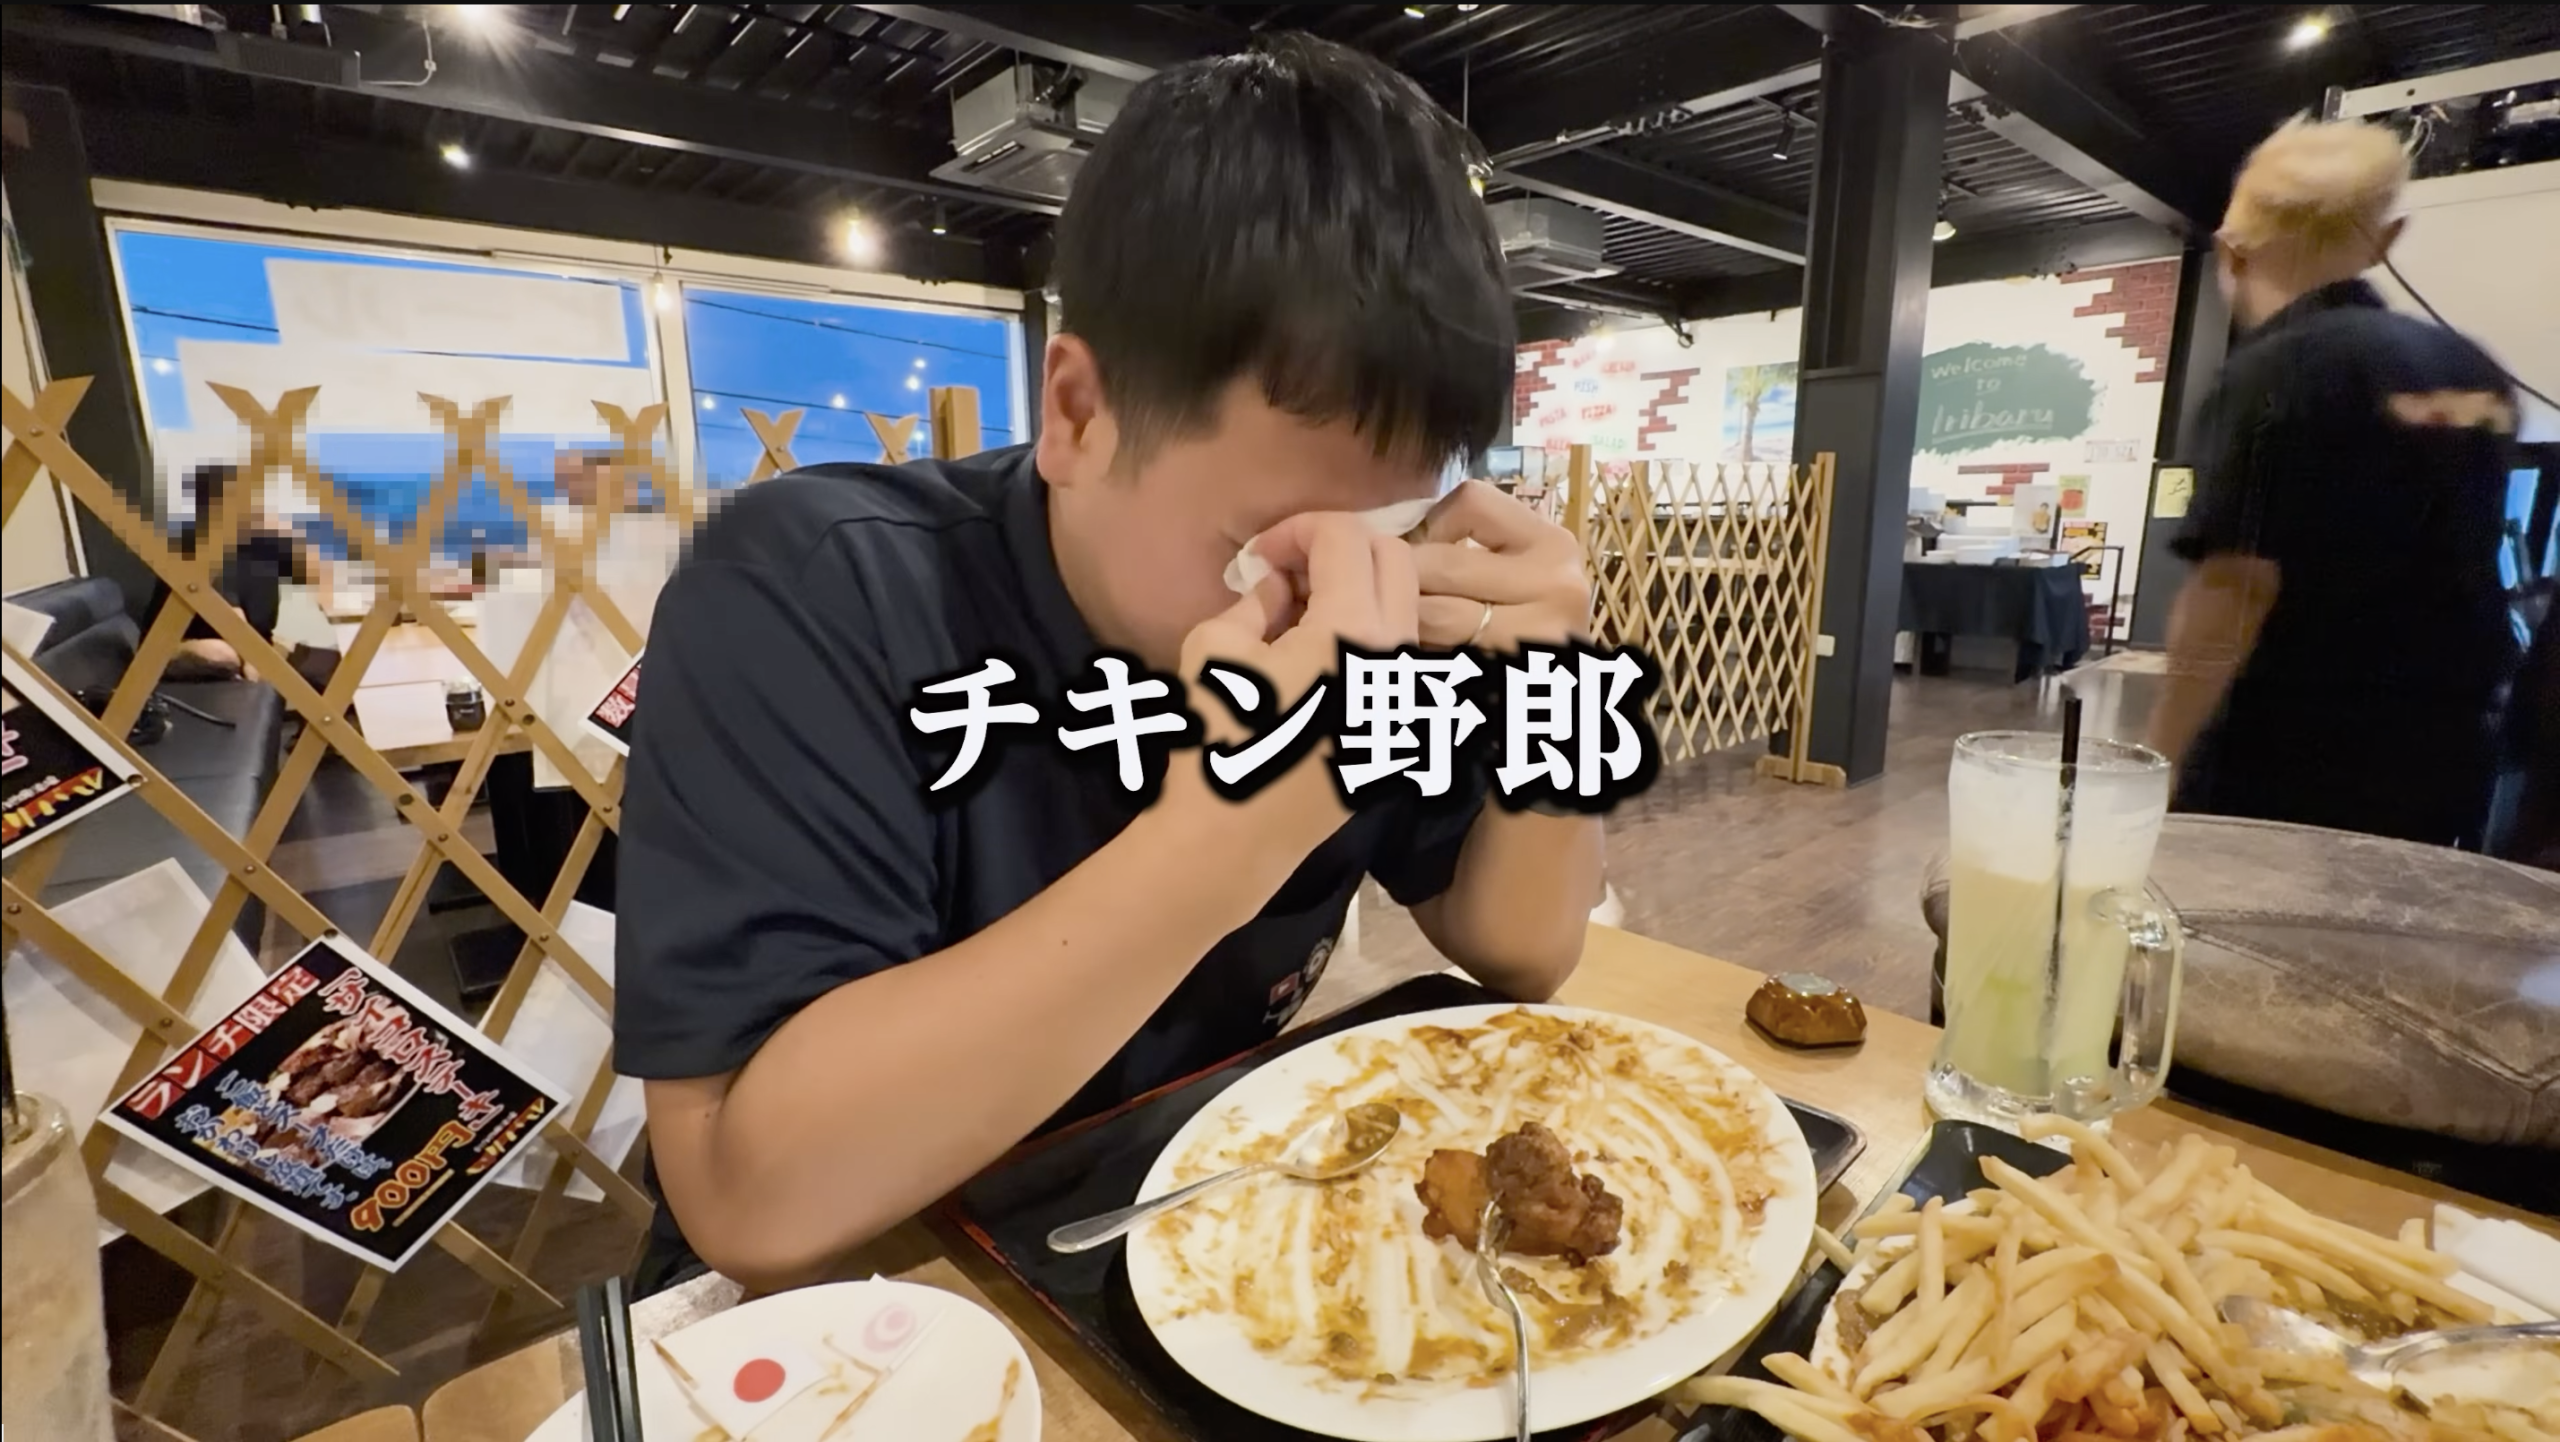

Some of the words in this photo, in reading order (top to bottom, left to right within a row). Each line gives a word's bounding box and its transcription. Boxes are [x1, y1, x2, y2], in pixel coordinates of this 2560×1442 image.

[1976, 378, 2002, 391] to
[126, 965, 321, 1119] ランチ限定
[350, 1119, 476, 1233] 900円
